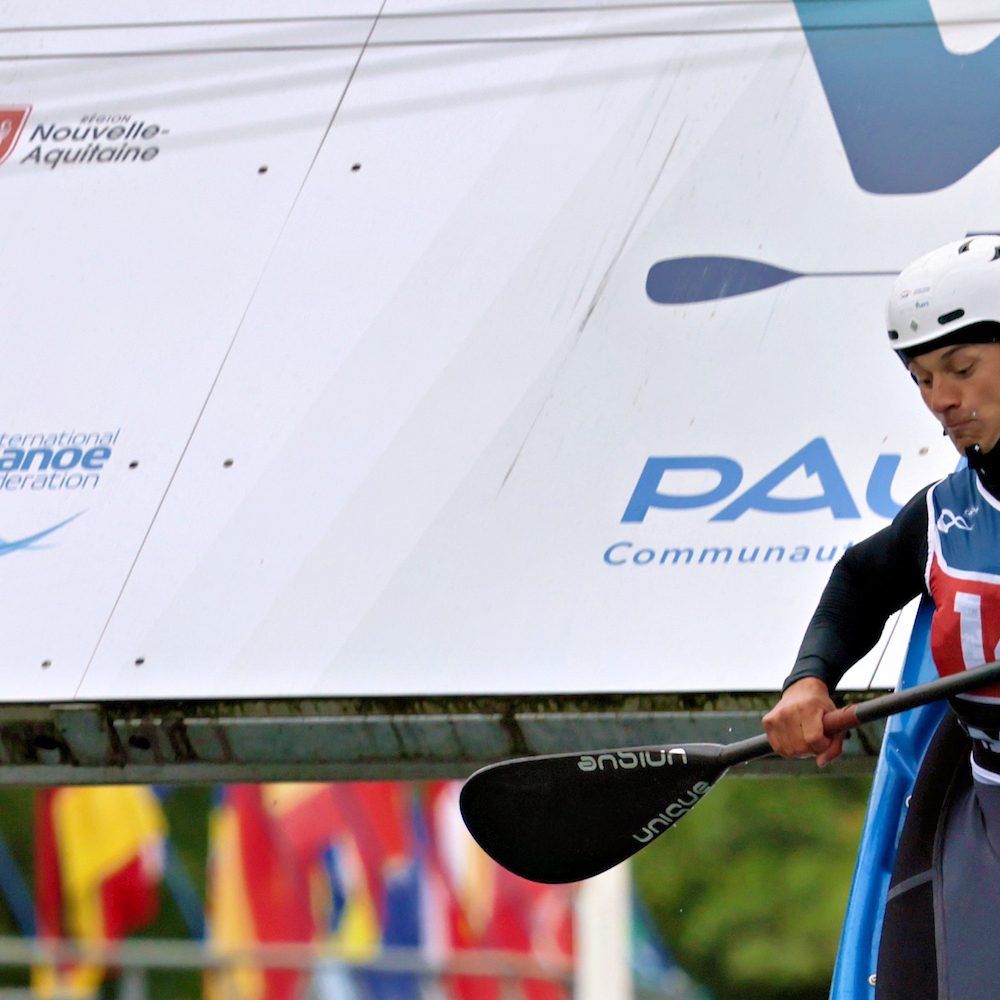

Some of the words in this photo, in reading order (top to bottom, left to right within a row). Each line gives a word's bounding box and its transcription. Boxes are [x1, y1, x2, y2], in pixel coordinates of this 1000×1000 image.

[80, 113, 132, 124] RÉGION
[29, 121, 170, 143] Nouvelle-
[20, 143, 160, 170] Aquitaine
[0, 446, 112, 471] anoe
